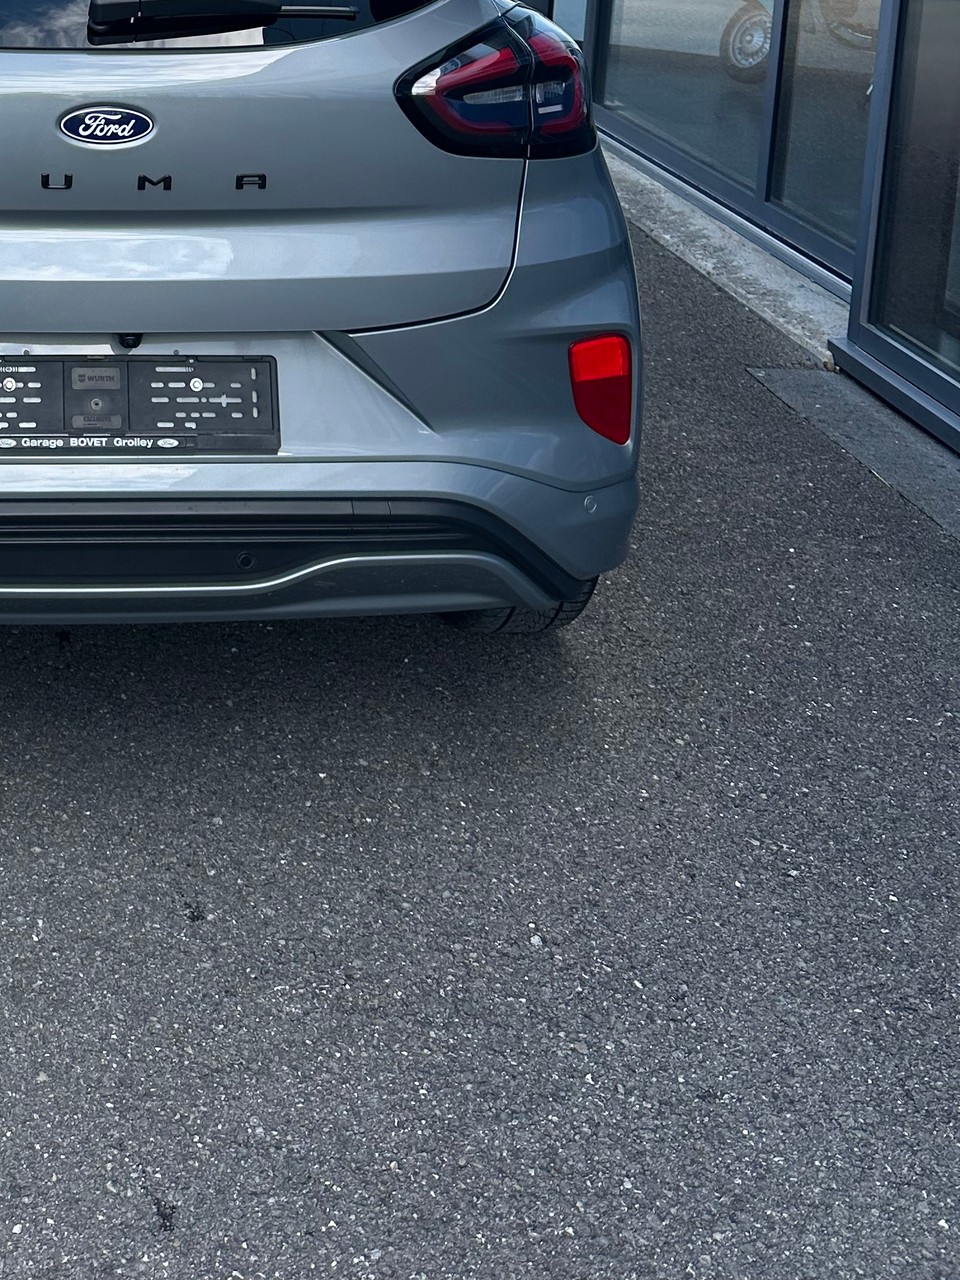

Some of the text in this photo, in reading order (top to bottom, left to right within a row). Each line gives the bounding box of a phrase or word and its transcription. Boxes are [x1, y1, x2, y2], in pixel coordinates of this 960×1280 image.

[79, 113, 135, 136] Ford
[21, 438, 64, 449] Garage
[70, 438, 108, 447] BOVET
[113, 437, 154, 449] Grolley
